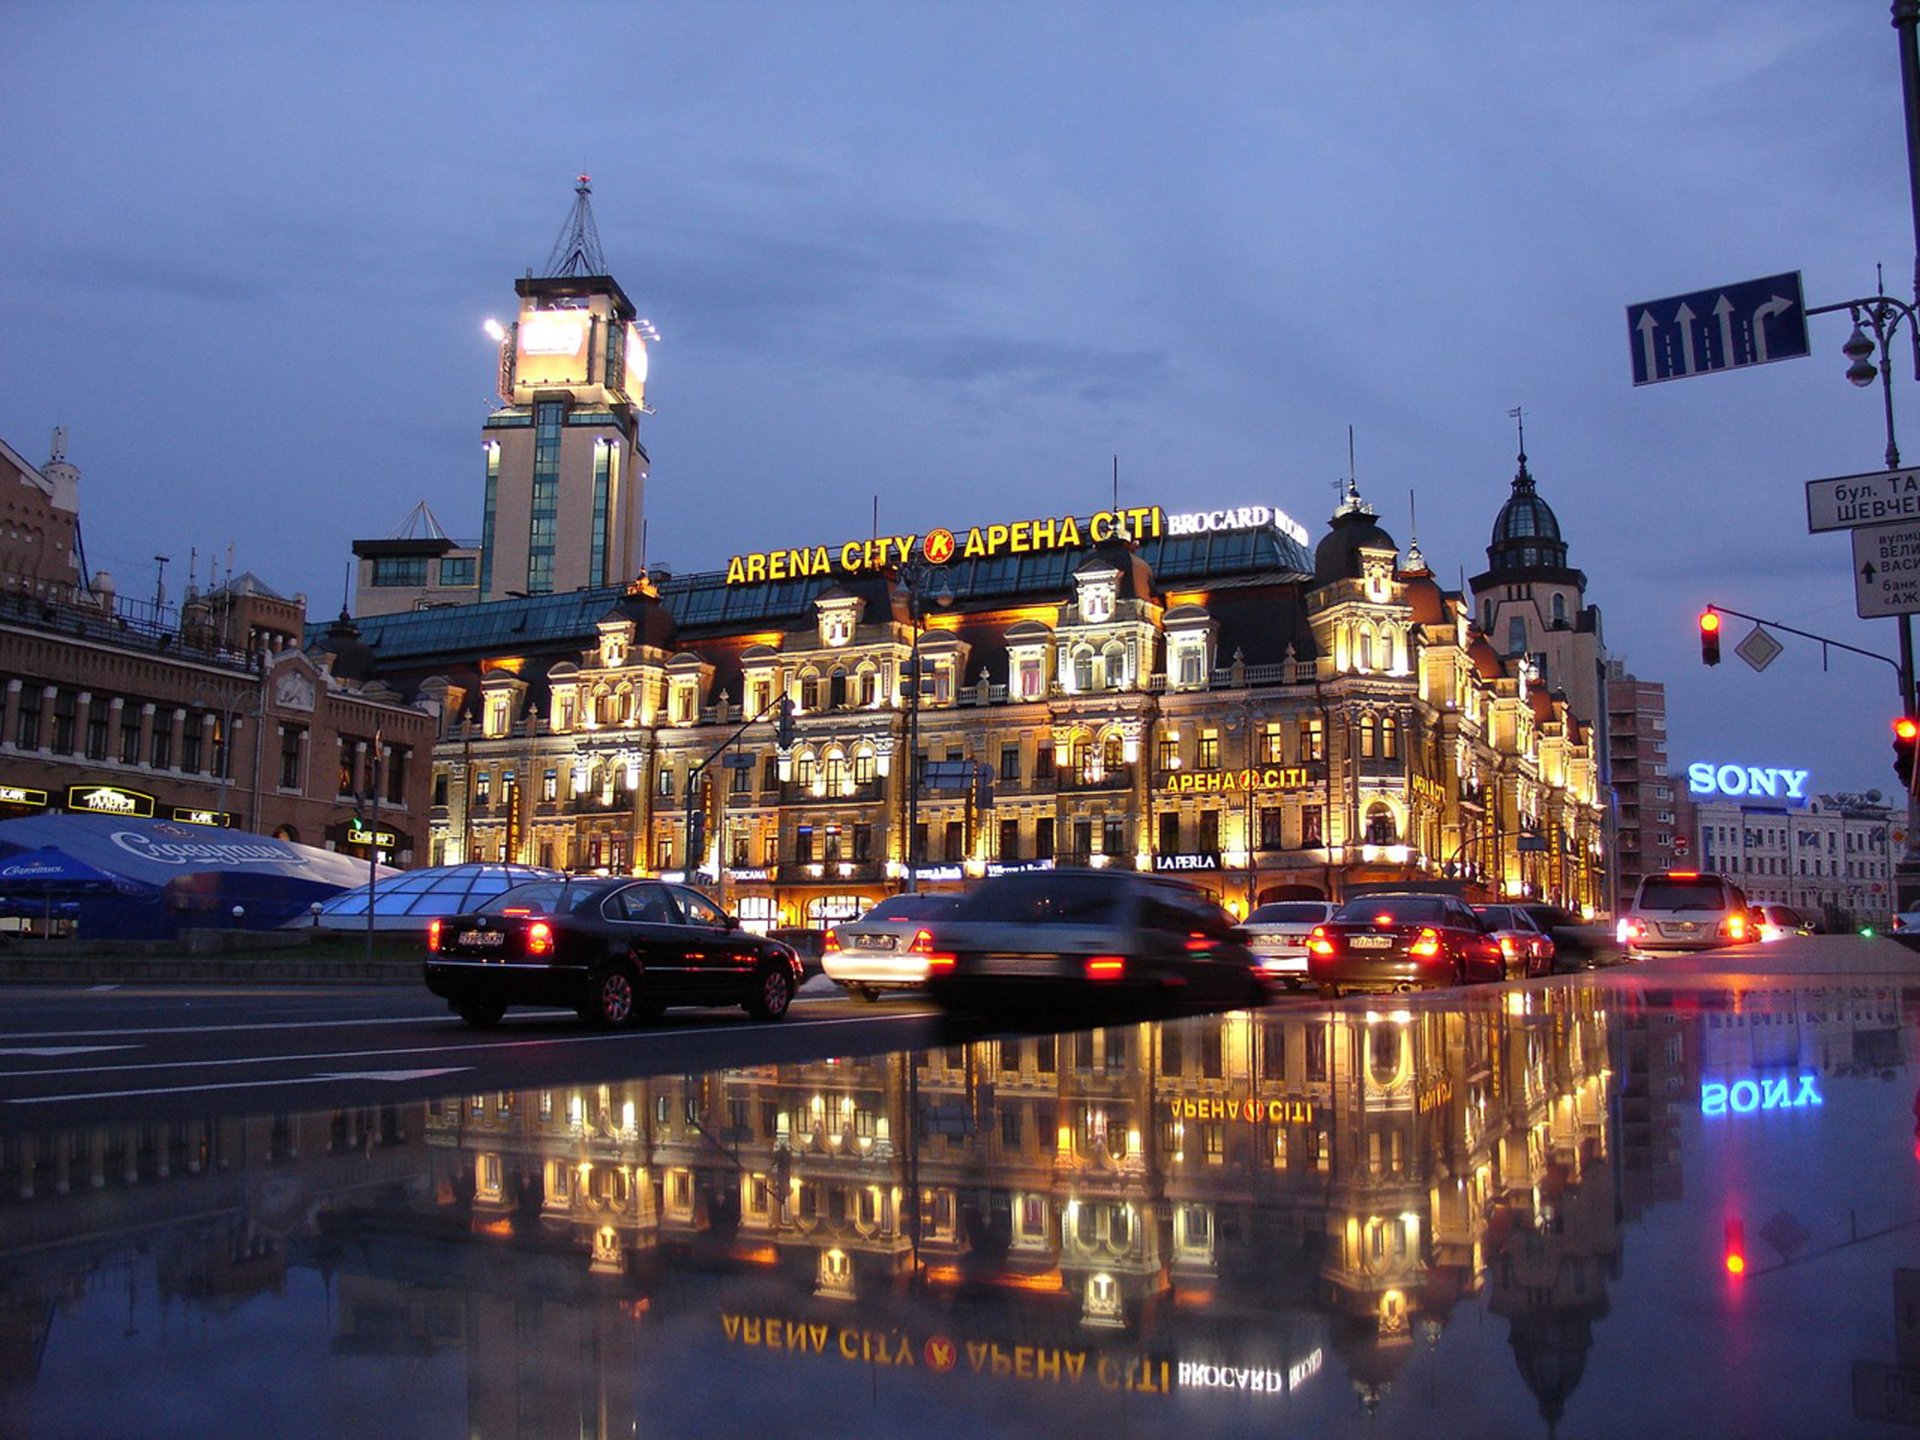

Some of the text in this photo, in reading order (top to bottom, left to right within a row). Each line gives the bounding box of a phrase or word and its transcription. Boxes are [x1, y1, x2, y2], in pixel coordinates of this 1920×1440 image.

[1835, 475, 1919, 503] бул. ТА
[1168, 505, 1270, 536] BROCARD
[1837, 496, 1920, 522] ШЕВЧЕ
[964, 515, 1081, 558] АРЕНА
[726, 545, 831, 585] ARENA
[841, 534, 916, 572] CITY
[1883, 579, 1918, 591] банк
[1167, 772, 1235, 793] АРЕНА
[1688, 762, 1808, 797] SONY
[1157, 855, 1215, 869] LA PERLA
